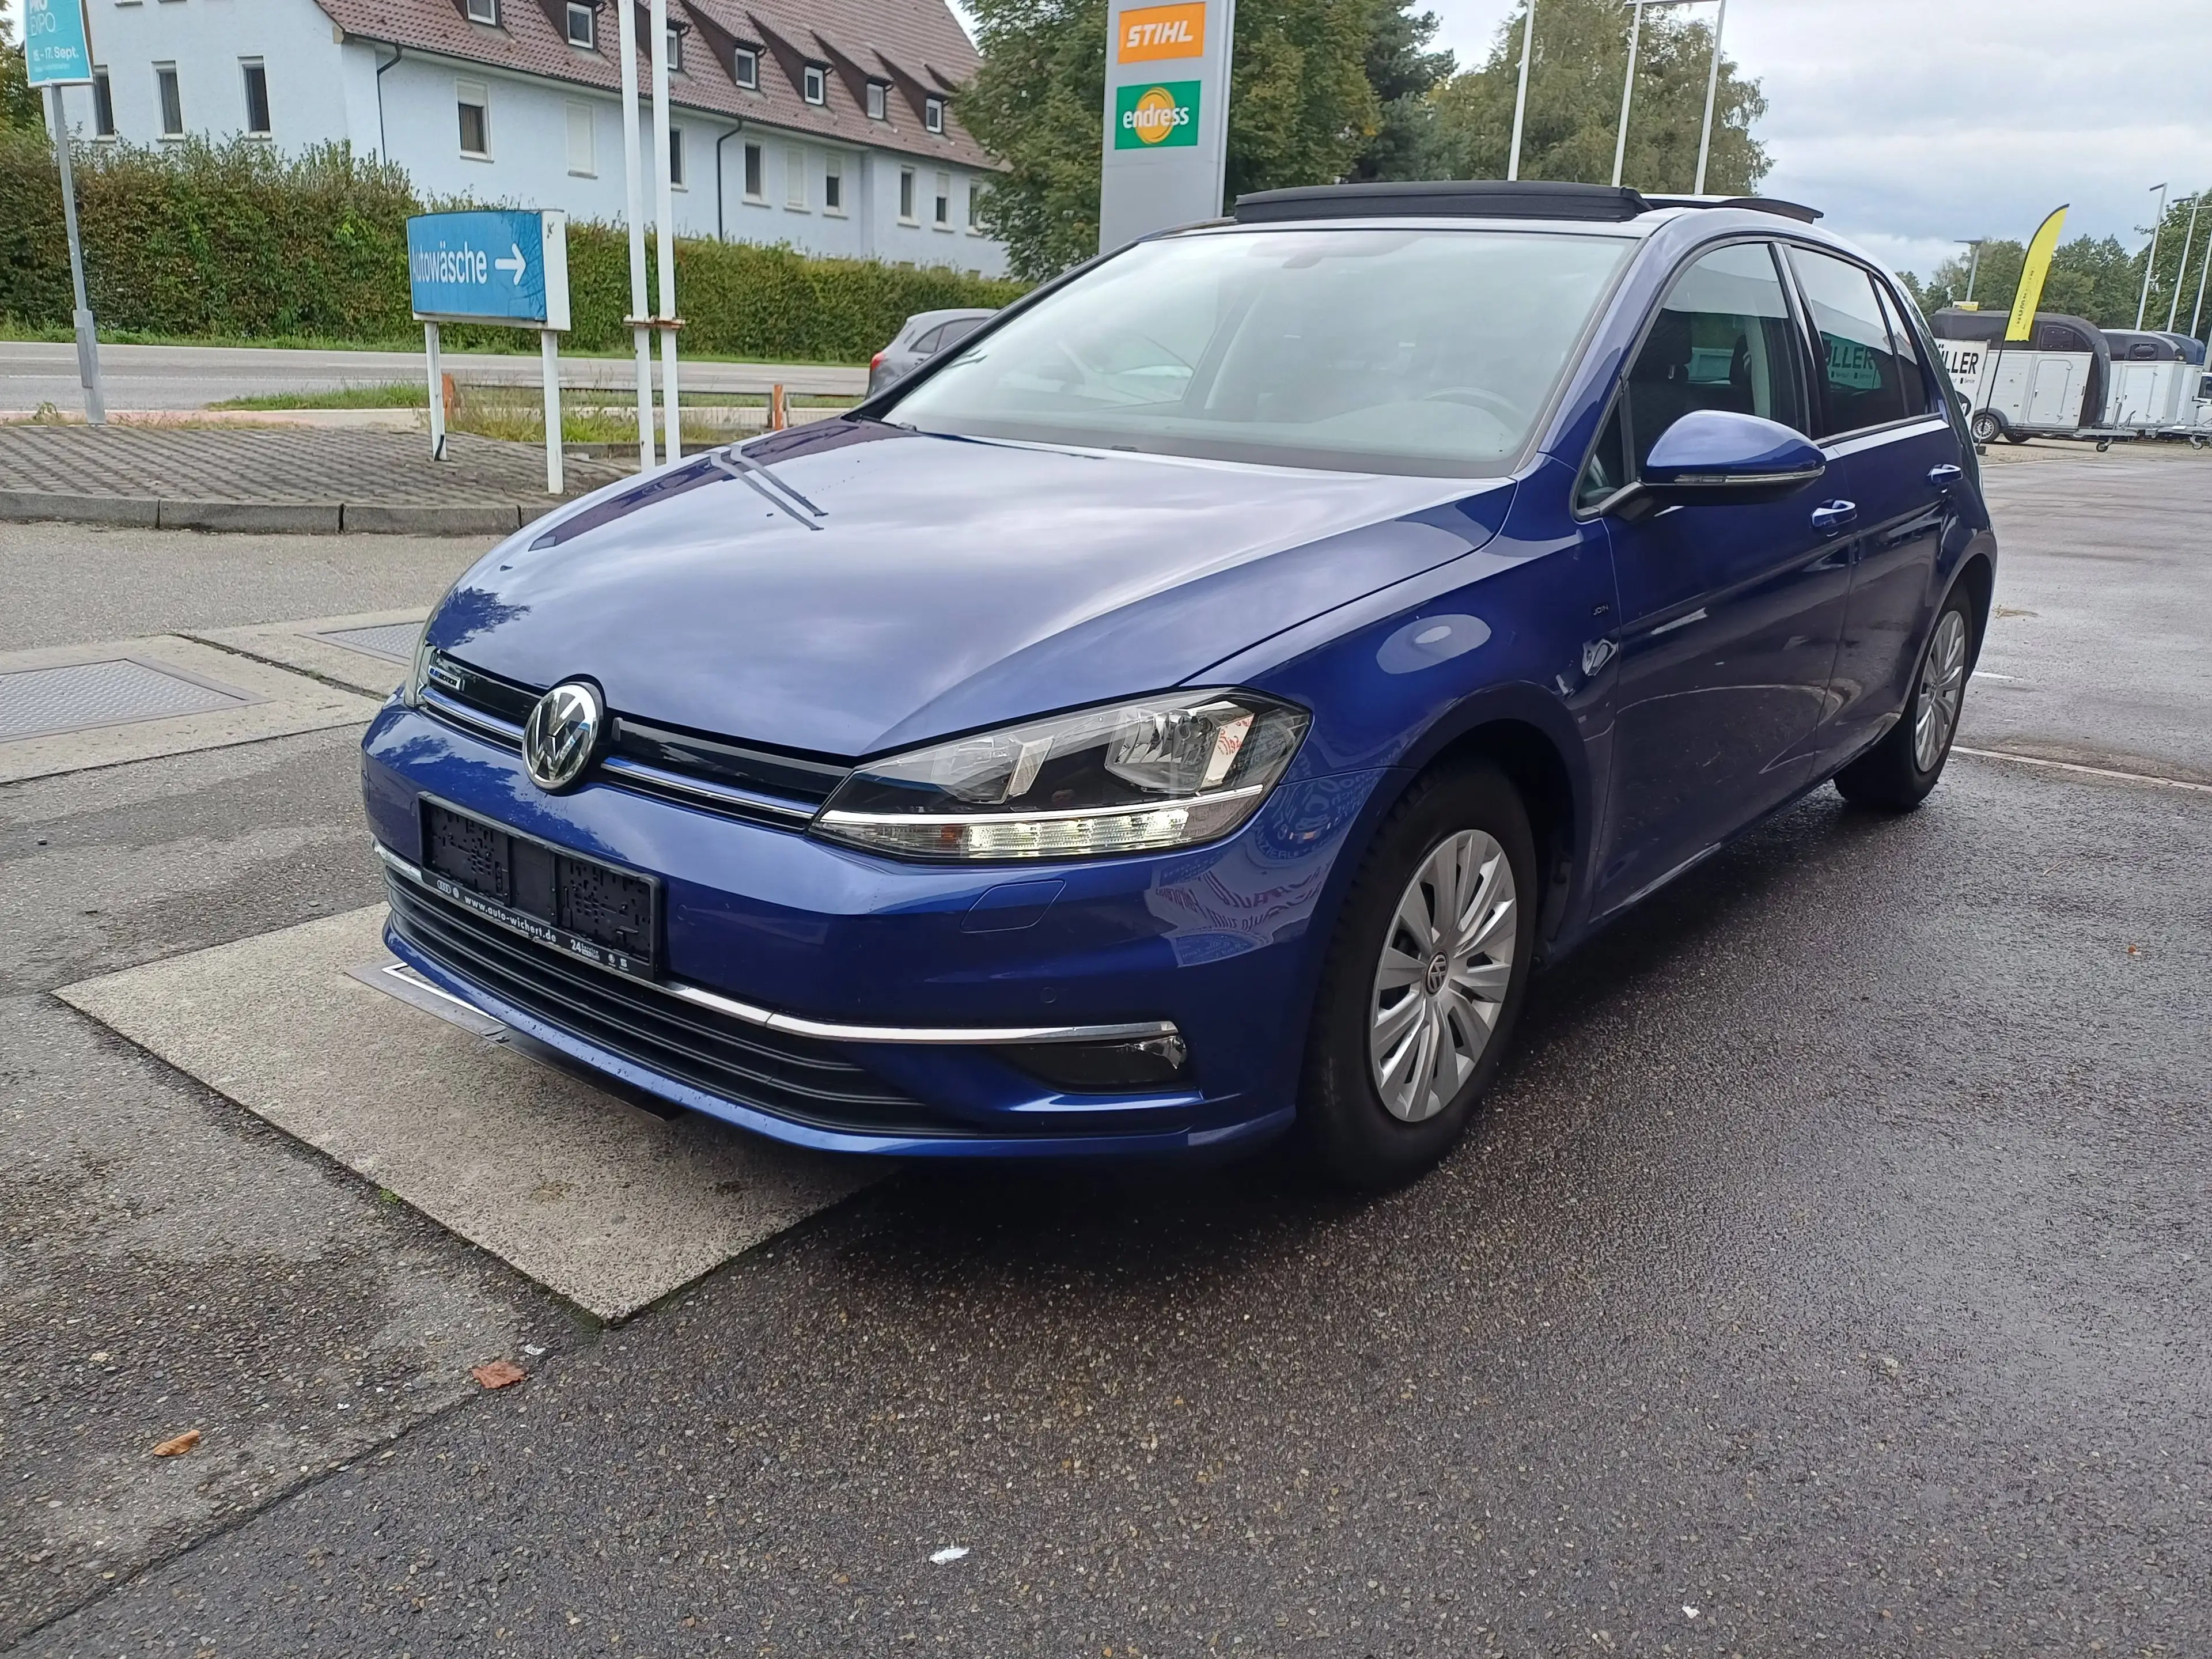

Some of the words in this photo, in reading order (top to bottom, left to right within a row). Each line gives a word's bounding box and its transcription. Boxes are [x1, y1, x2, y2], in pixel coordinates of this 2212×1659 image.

[1126, 20, 1194, 48] STIHL
[54, 46, 79, 61] Sept.
[1123, 103, 1190, 128] endress
[412, 240, 487, 284] Autowäsche
[1593, 604, 1609, 615] JOIN
[464, 895, 556, 942] www.auto-wichert.de
[570, 939, 581, 953] 24
